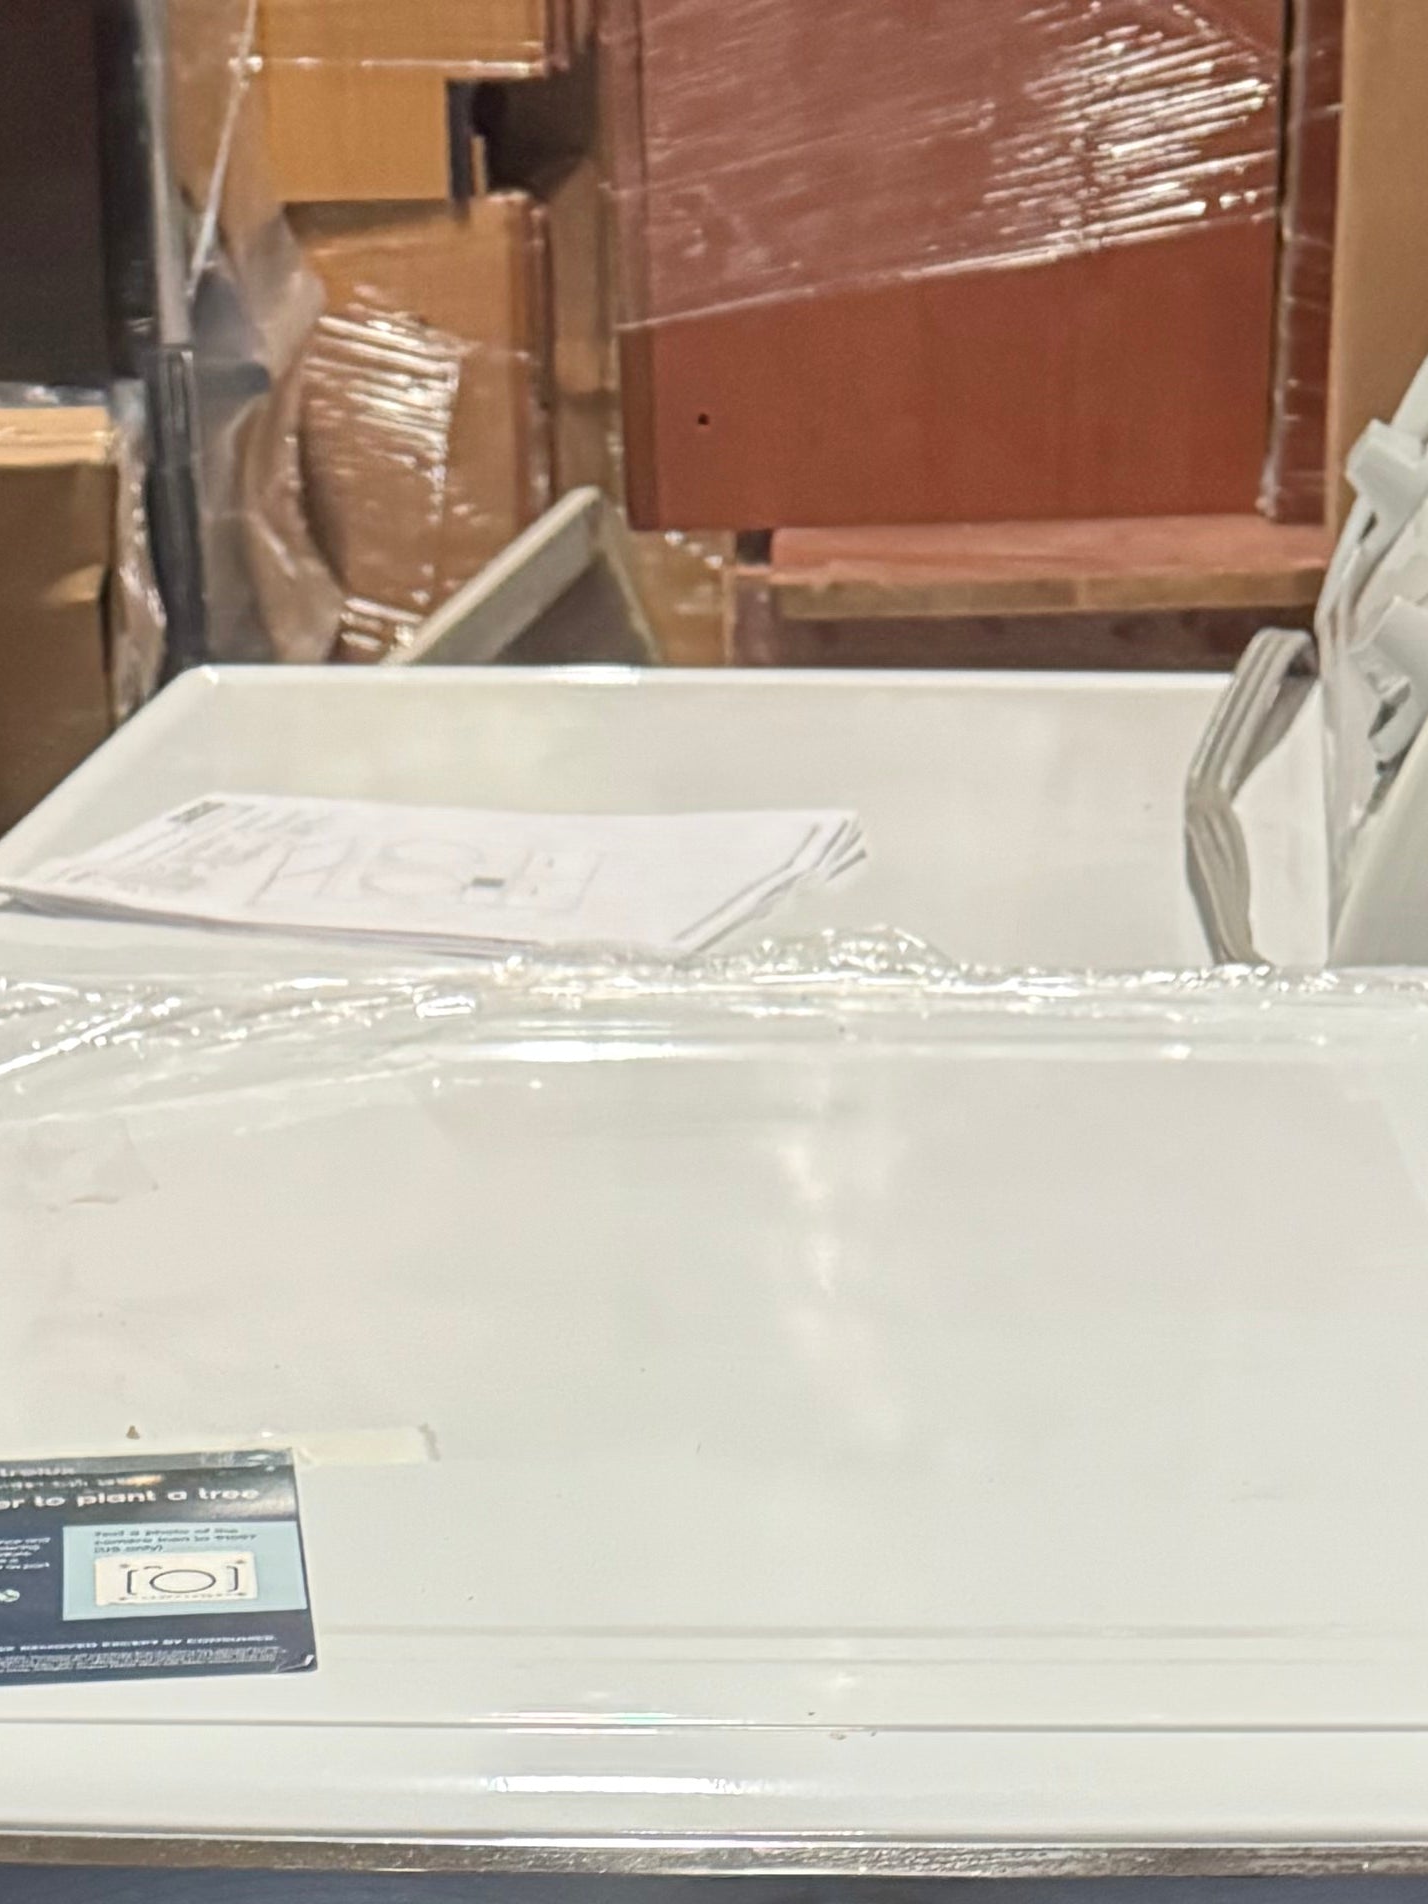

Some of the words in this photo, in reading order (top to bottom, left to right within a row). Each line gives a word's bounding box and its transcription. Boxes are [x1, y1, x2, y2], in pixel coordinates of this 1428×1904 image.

[35, 1495, 66, 1507] to
[77, 1489, 157, 1507] plant
[167, 1490, 187, 1501] a
[198, 1488, 260, 1500] tree
